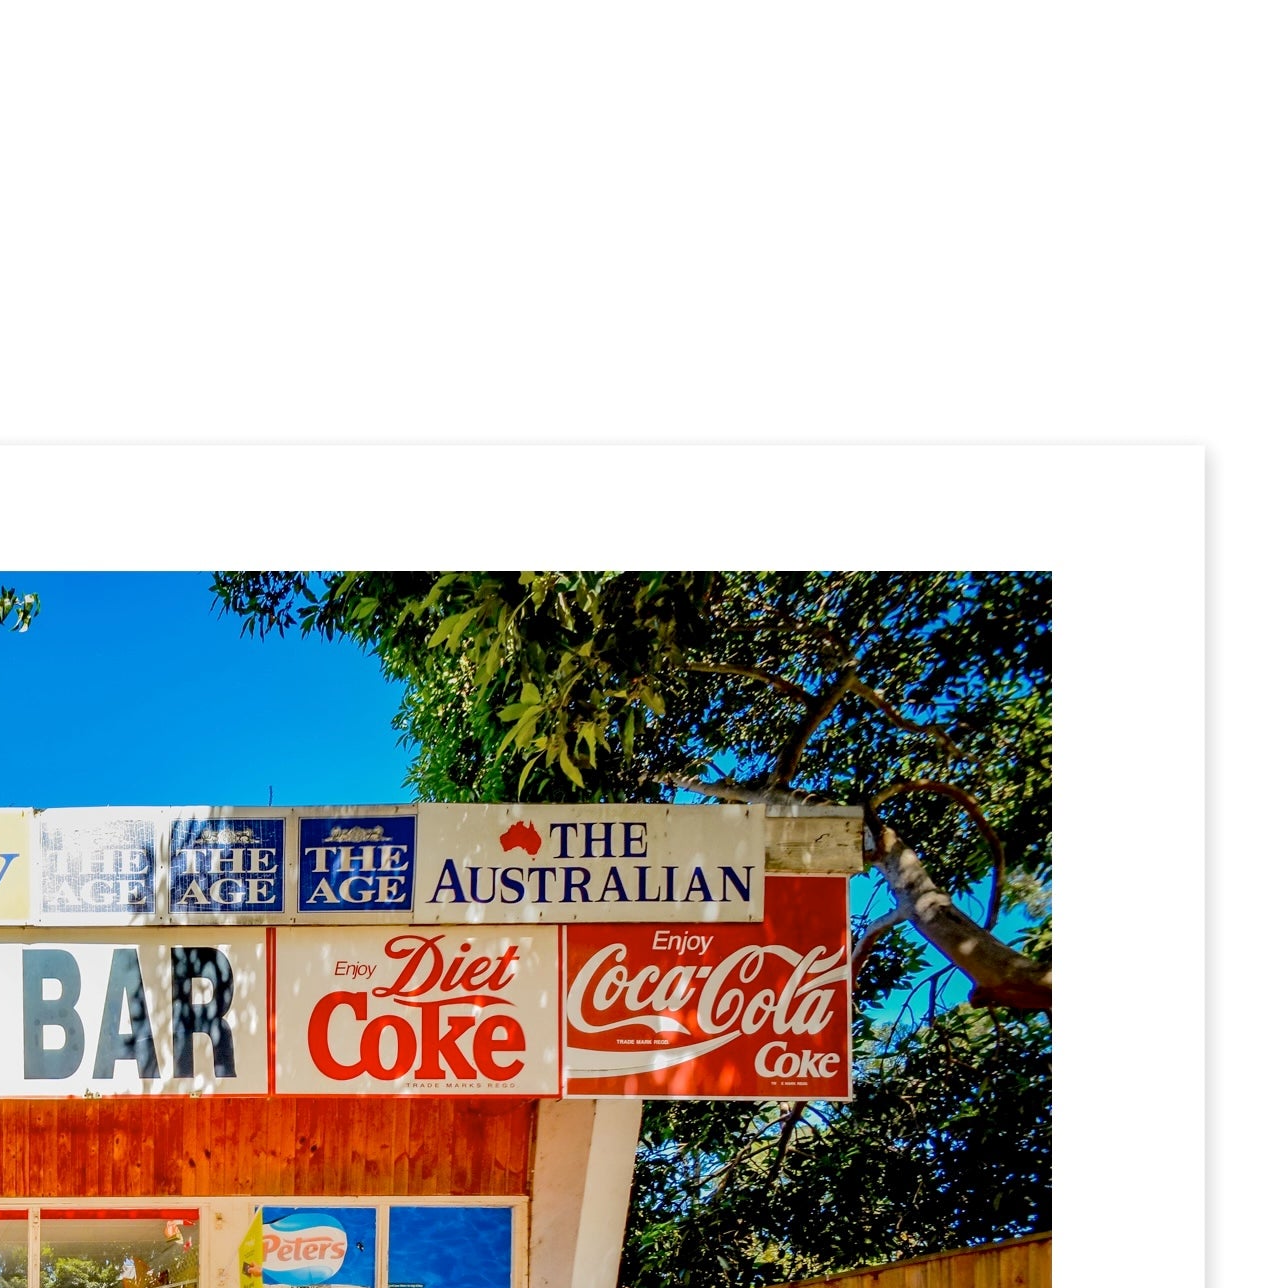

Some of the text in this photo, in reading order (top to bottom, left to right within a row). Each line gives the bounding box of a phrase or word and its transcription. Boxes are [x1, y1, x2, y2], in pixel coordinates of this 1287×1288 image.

[549, 821, 649, 859] THE
[47, 848, 149, 875] THE
[176, 848, 278, 875] THE
[305, 844, 409, 873] THE
[48, 879, 148, 905] AGE
[177, 877, 277, 905] AGE
[306, 875, 408, 905] AGE
[427, 858, 756, 904] AUSTRALIAN
[652, 929, 715, 956] Enjoy
[334, 960, 378, 980] Enjoy
[372, 934, 520, 998] Diet
[567, 942, 848, 1037] Coca-Cola
[22, 947, 238, 1080] BAR
[307, 990, 527, 1082] Coke
[755, 1040, 841, 1078] Coke
[262, 1233, 347, 1262] Peters
